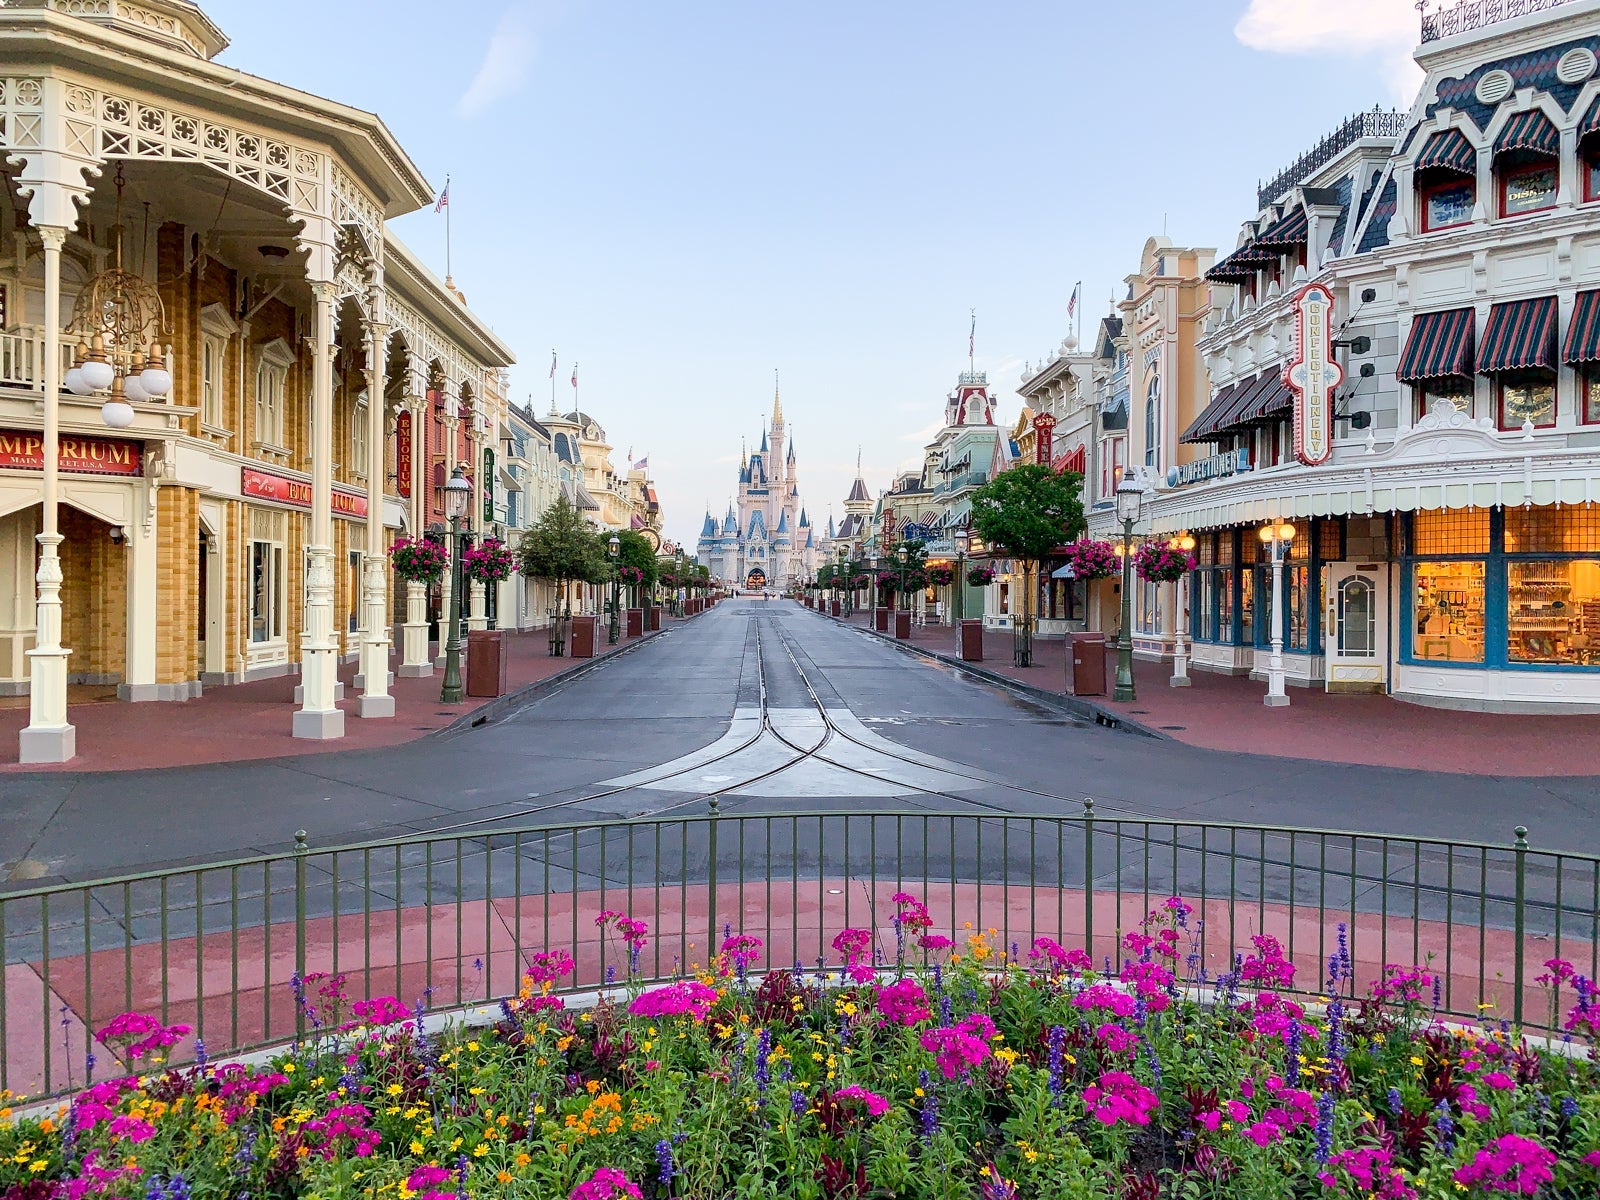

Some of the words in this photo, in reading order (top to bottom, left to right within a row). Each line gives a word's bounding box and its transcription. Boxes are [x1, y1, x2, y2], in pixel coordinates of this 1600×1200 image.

[1508, 189, 1551, 201] DISN
[1309, 303, 1322, 452] CONFECTIONERY
[10, 456, 37, 464] MAIN
[400, 419, 411, 489] EMPORIUM
[1041, 428, 1050, 468] CINE
[287, 482, 356, 512] EMIUM
